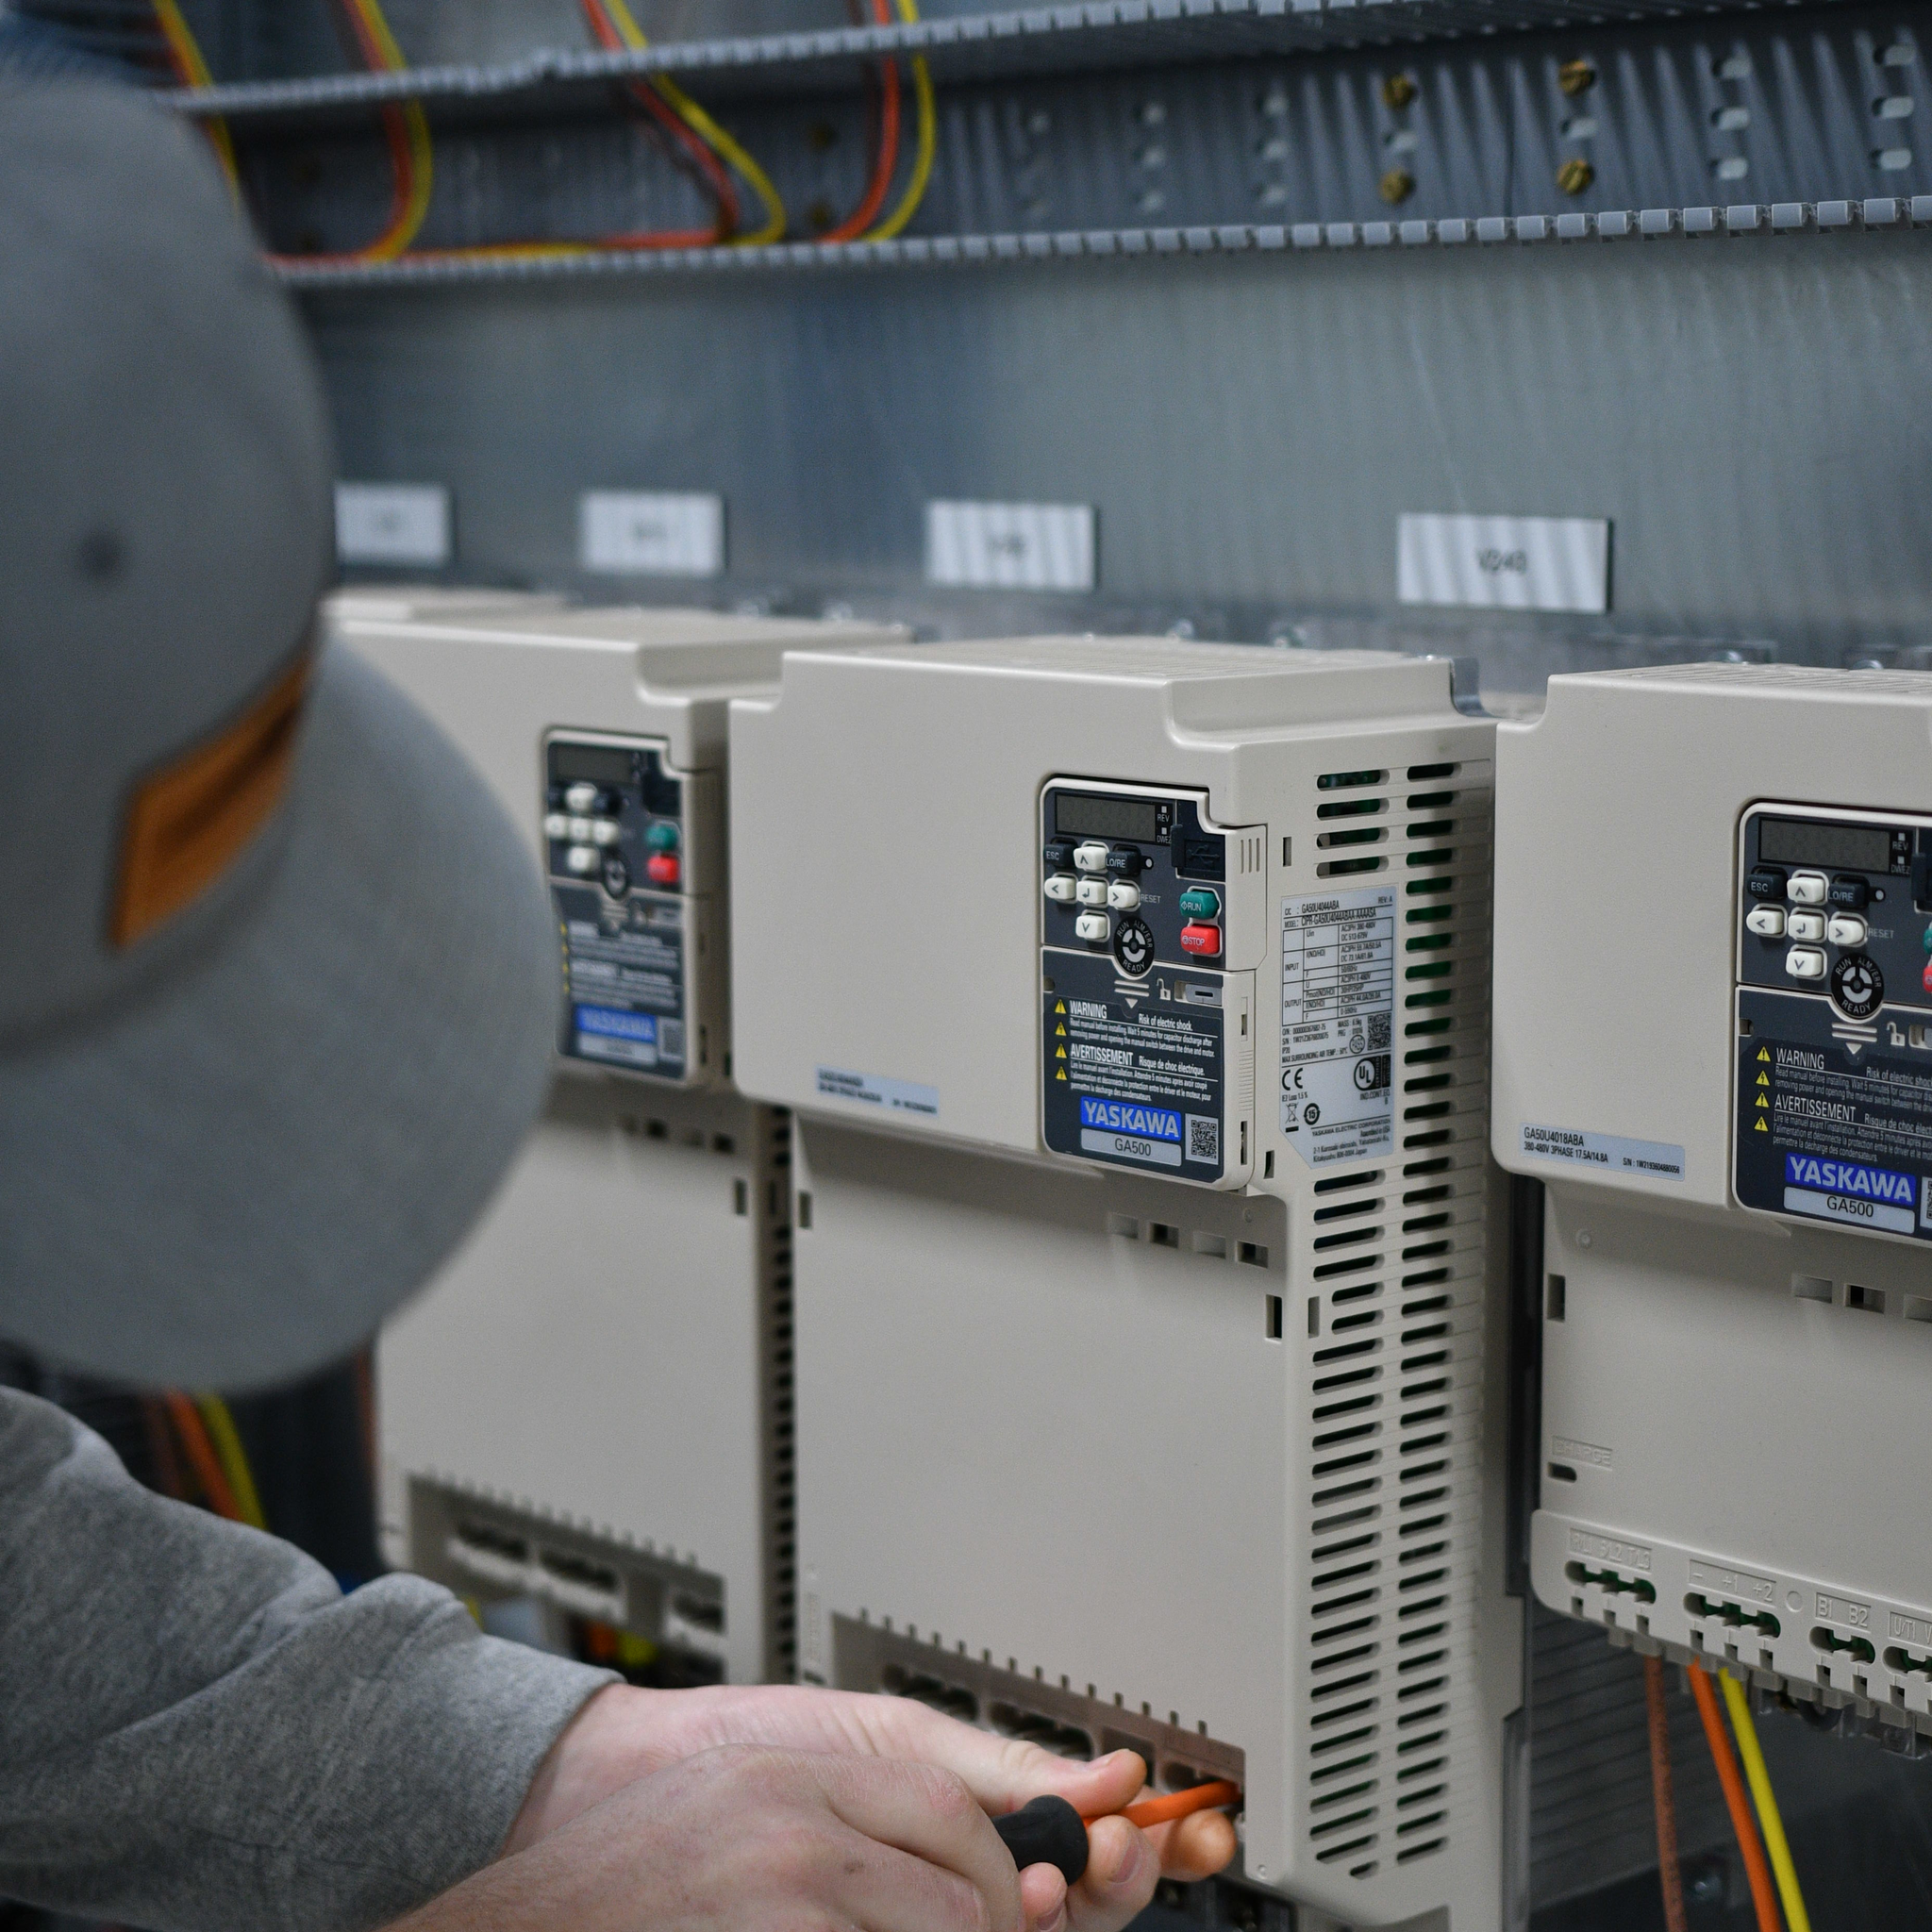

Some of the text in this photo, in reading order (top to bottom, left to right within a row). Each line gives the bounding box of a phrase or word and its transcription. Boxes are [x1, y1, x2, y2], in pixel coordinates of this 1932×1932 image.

[1157, 813, 1170, 823] REV
[1892, 841, 1908, 851] REV
[1046, 851, 1060, 860] ESC
[1106, 857, 1126, 868] LO/RE
[1751, 882, 1768, 892] ESC
[1140, 893, 1160, 904] RESET
[1828, 890, 1854, 902] LO/RE
[1187, 902, 1202, 911] RUN
[1117, 921, 1130, 938] RUN
[1868, 928, 1894, 940] RESET
[1189, 938, 1206, 947] STOP
[1123, 958, 1146, 974] READY
[1285, 962, 1299, 971] INPUT
[1836, 958, 1852, 975] RUN
[1857, 957, 1881, 989] ALM/ERR
[1285, 999, 1302, 1008] OUTPUT
[1841, 1000, 1872, 1015] READY
[1070, 1000, 1108, 1019] WARNING
[1139, 1013, 1149, 1024] Risk
[1151, 1015, 1157, 1025] of
[1157, 1016, 1175, 1028] electric
[1071, 1043, 1134, 1065] AVERTISSEMENT
[1139, 1056, 1157, 1069] Risque
[1158, 1058, 1164, 1069] de
[1165, 1060, 1177, 1072] choc
[1776, 1047, 1914, 1085] WARNING Risk of electric
[1084, 1100, 1179, 1138] YASKAWA
[1774, 1093, 1857, 1122] AVERTISSEMENT
[1865, 1113, 1887, 1128] Risque
[1889, 1118, 1897, 1129] de
[1898, 1120, 1914, 1132] choc
[1524, 1126, 1584, 1147] GA50U4018ABA
[1115, 1138, 1151, 1157] GA500
[1524, 1141, 1549, 1154] 380-480V
[1551, 1144, 1574, 1158] 3PHASE
[1575, 1149, 1608, 1163] 17.5A/14.8A
[1623, 1158, 1632, 1166] S/N
[1790, 1156, 1912, 1202] YASKAWA
[1826, 1196, 1874, 1218] GA500
[1752, 1583, 1774, 1603] +2
[1848, 1605, 1869, 1628] B2
